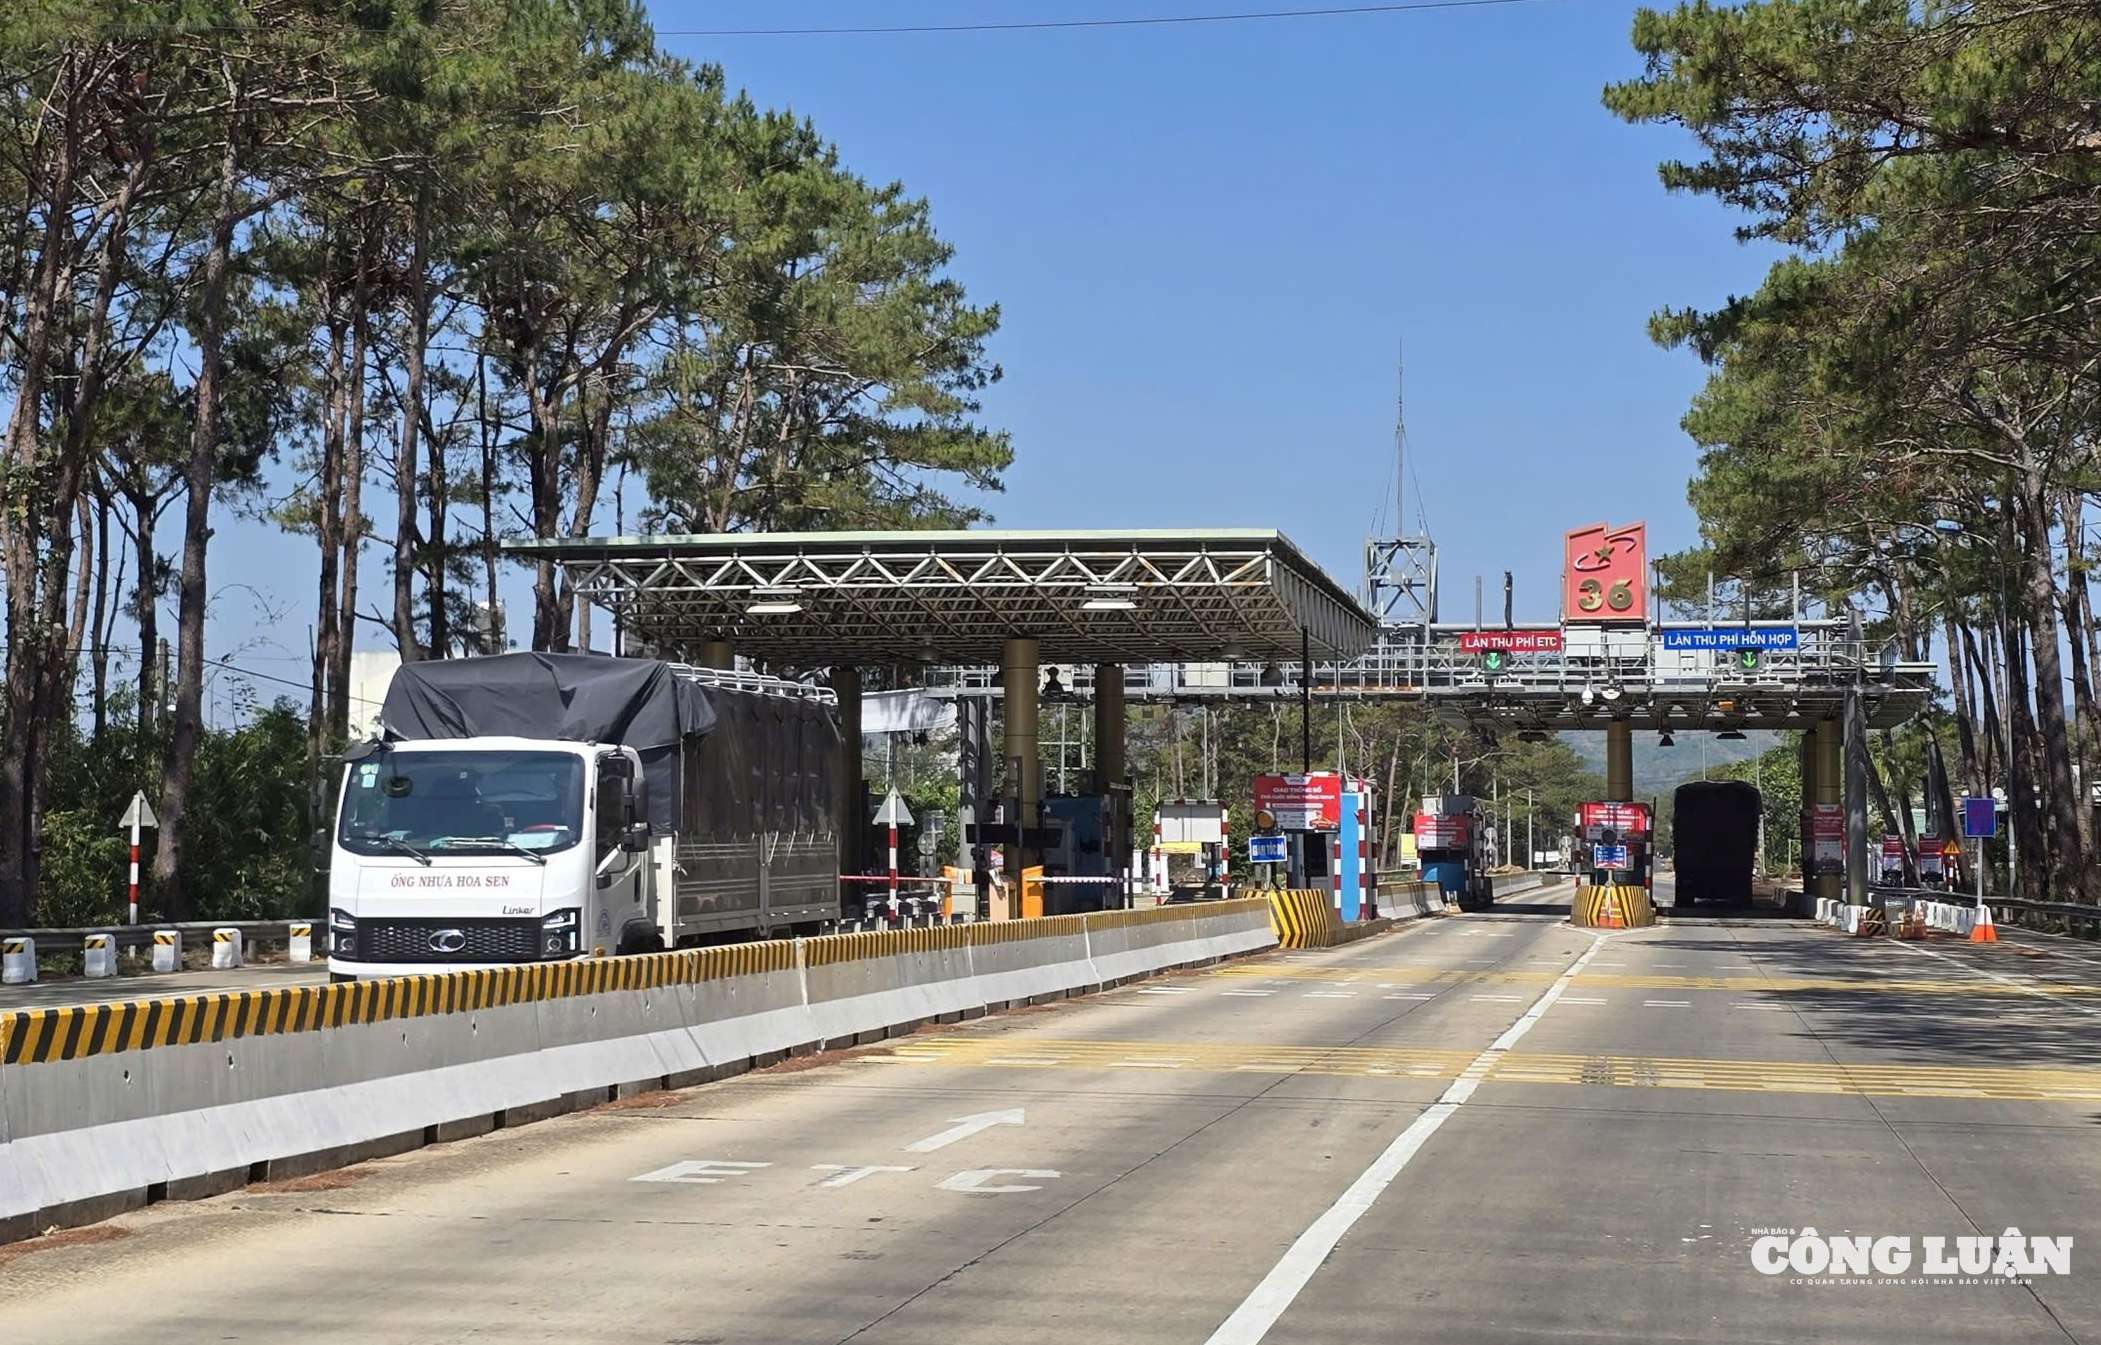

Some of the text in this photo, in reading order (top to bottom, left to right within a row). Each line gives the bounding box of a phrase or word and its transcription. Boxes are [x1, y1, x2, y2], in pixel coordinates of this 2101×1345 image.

[1578, 579, 1633, 612] 36
[1465, 633, 1557, 648] LÀN THU PHÍ ETC
[1668, 630, 1792, 647] LÀN THU PHÍ HỖN HỢP
[391, 872, 510, 890] ỐNG NHỰA HOA SEN
[502, 905, 535, 915] Linker
[628, 1159, 1062, 1193] ETC
